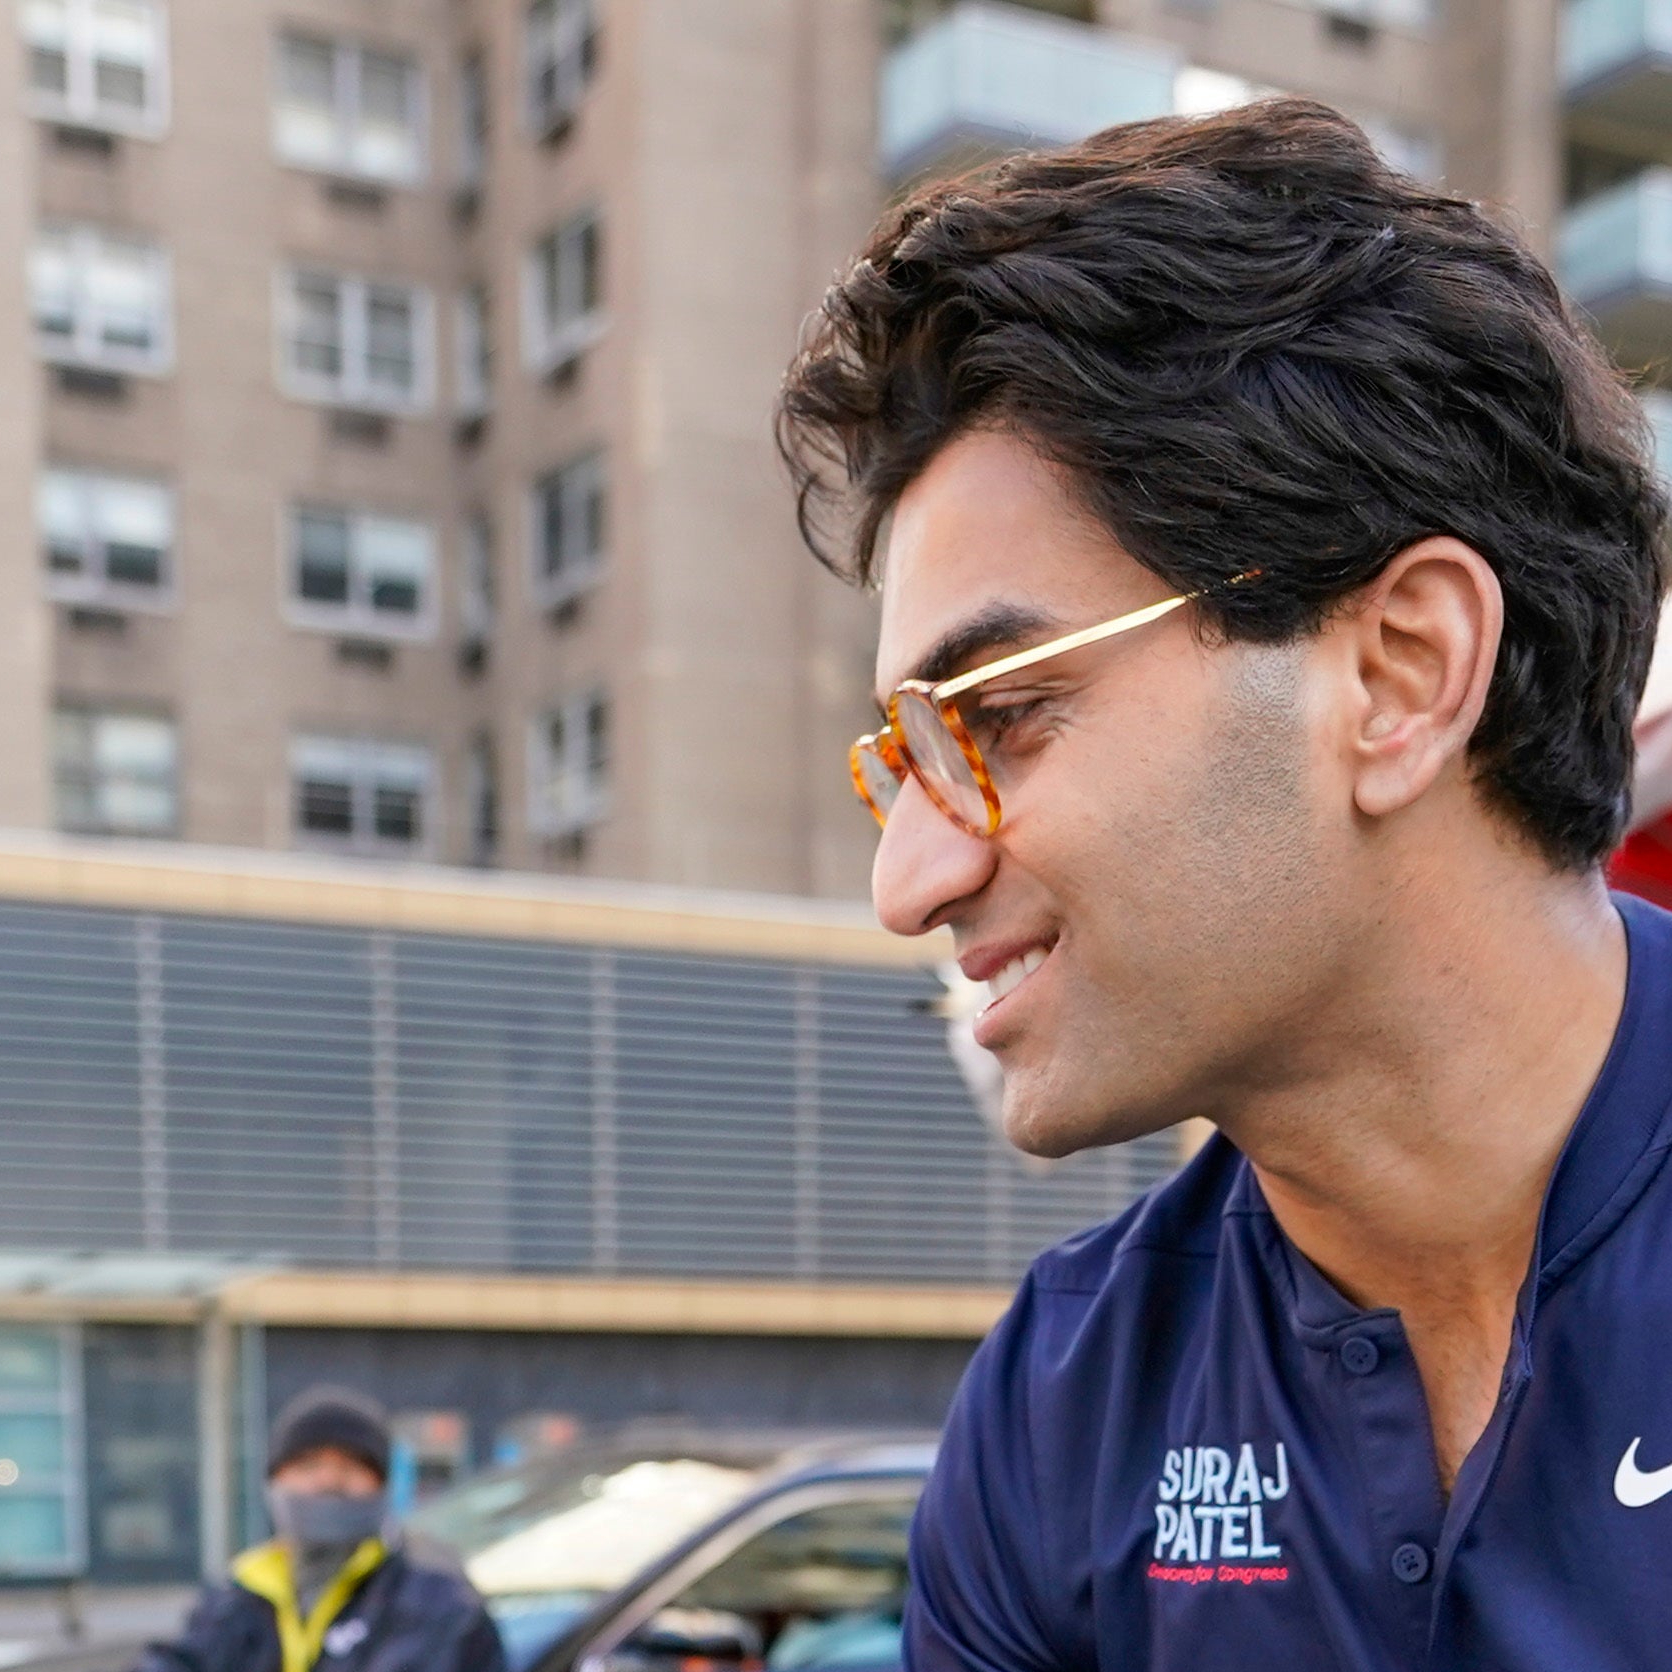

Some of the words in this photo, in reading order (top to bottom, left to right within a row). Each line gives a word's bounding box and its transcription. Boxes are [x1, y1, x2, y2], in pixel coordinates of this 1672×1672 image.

[1157, 1442, 1289, 1505] SURAJ
[1153, 1503, 1282, 1562] PATEL
[1217, 1564, 1289, 1586] Congress
